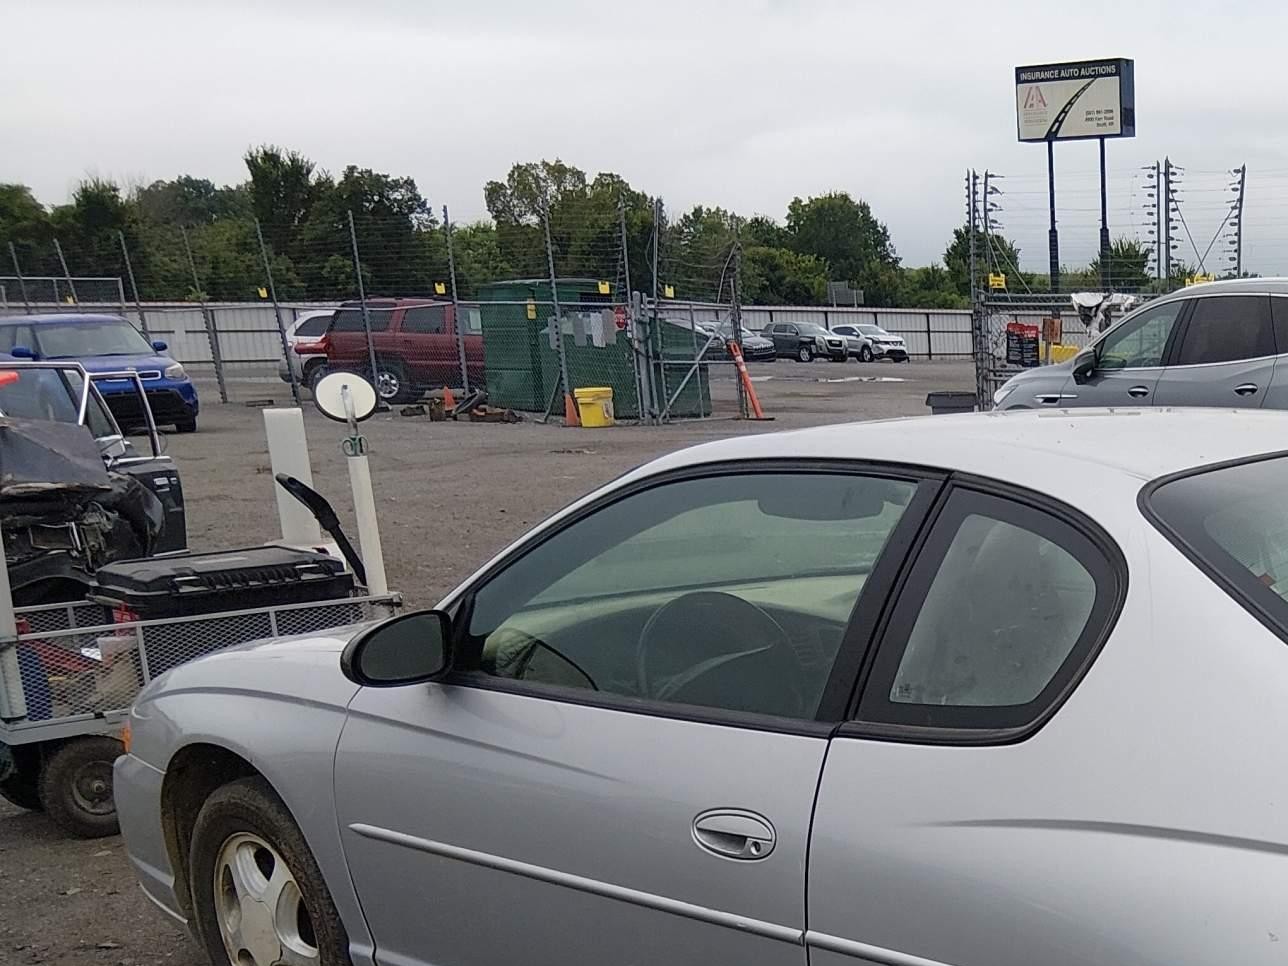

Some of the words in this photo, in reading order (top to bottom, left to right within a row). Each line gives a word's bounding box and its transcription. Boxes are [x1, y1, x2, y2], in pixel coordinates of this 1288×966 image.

[1020, 69, 1059, 81] INSURANCE
[1060, 68, 1079, 78] AUTO
[1080, 65, 1116, 76] AUCTIONS
